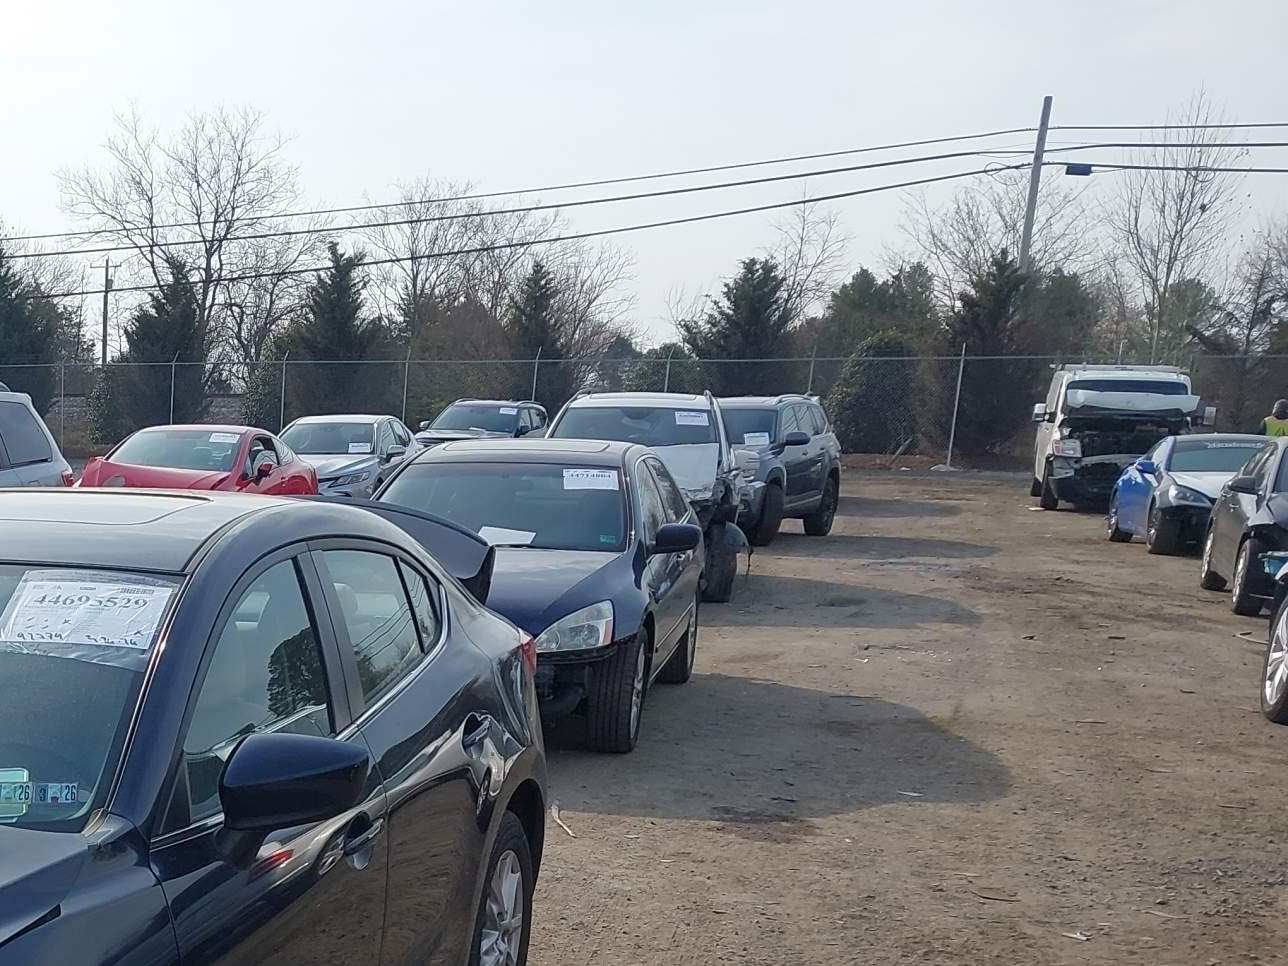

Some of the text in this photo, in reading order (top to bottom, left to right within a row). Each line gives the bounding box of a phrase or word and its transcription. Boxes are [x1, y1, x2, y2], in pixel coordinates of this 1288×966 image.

[33, 593, 149, 609] 44695529
[18, 785, 30, 801] 26
[39, 785, 77, 802] 3 26
